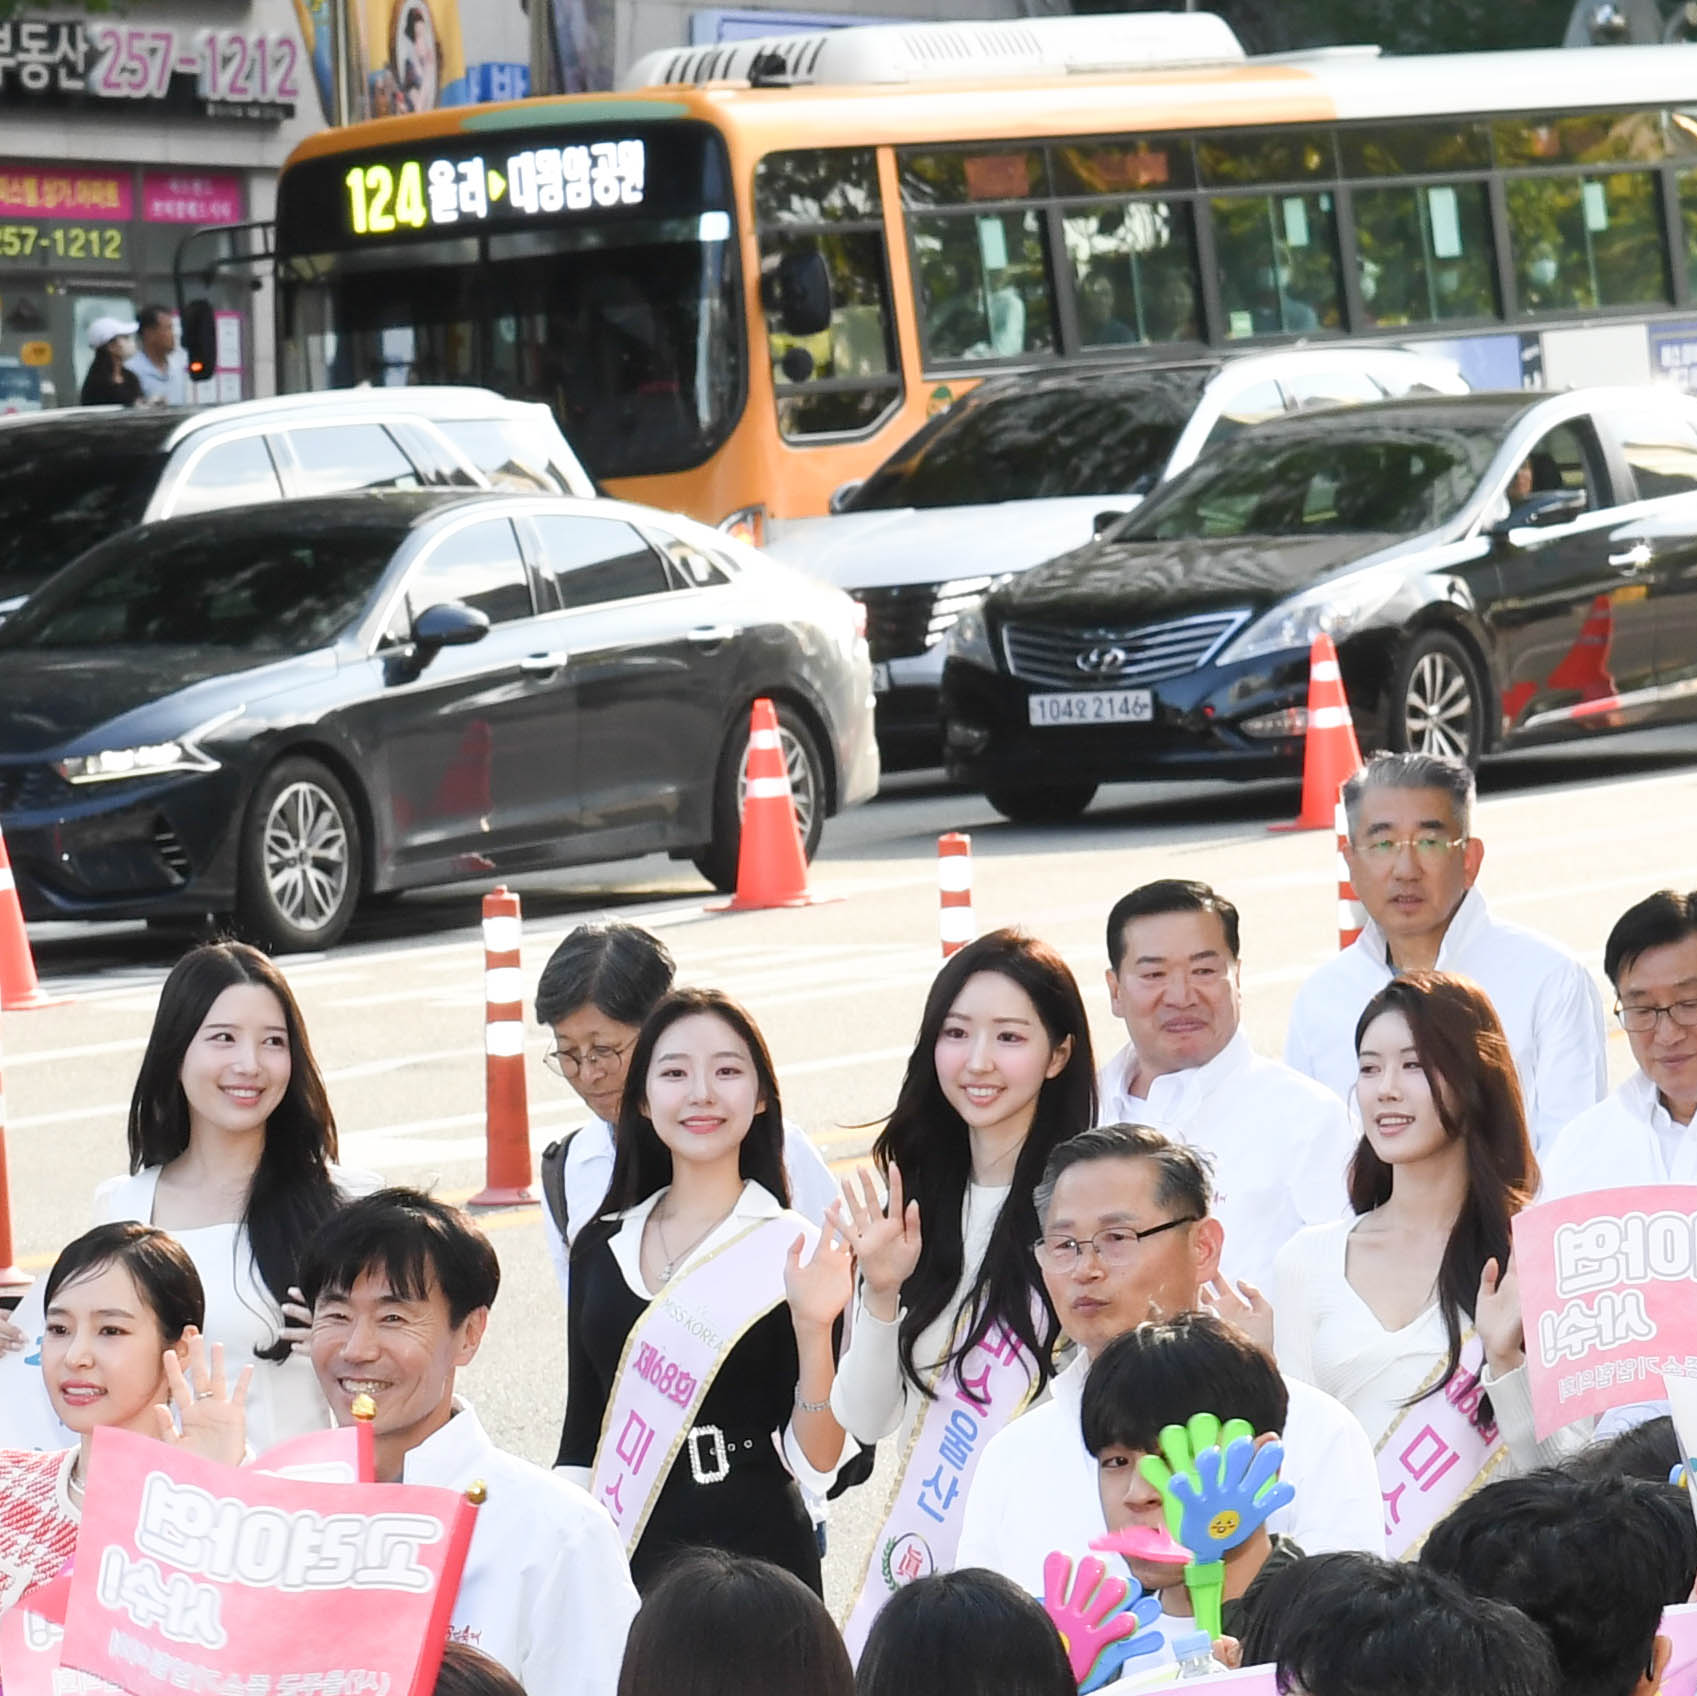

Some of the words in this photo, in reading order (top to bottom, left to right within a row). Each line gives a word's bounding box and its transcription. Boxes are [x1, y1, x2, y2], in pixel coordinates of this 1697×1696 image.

[92, 27, 300, 99] 257-1212
[346, 161, 427, 234] 124
[427, 157, 488, 224] 율리
[1039, 697, 1086, 722] 104오
[1092, 695, 1144, 719] 2146
[682, 1314, 726, 1353] KOREA
[632, 1339, 698, 1409] 제68회
